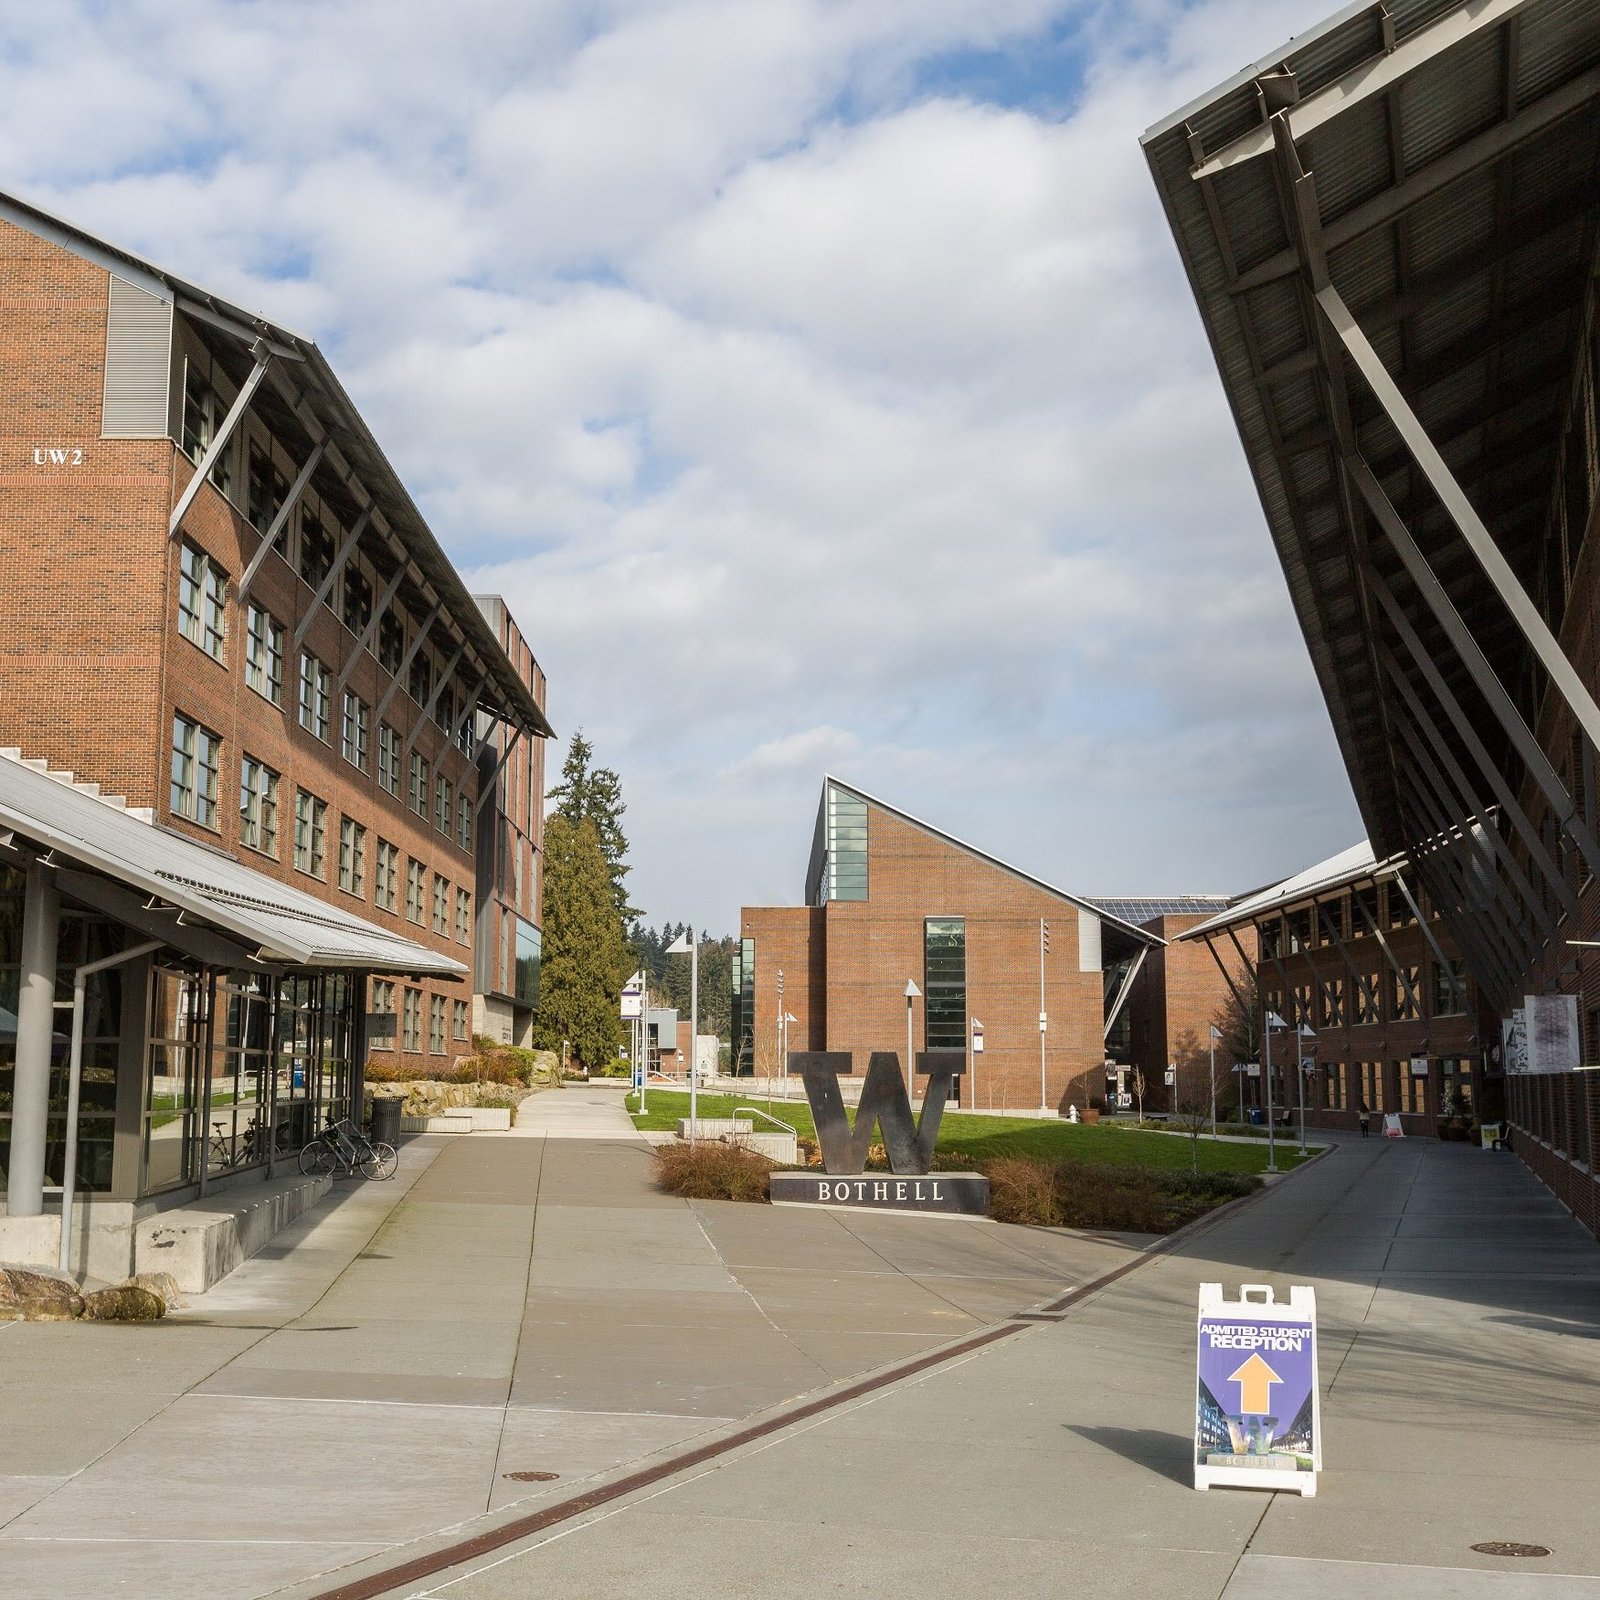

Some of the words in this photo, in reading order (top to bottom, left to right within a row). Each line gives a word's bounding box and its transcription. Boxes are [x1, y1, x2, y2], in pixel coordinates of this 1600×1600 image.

[788, 1051, 966, 1175] W
[818, 1182, 944, 1201] BOTHELL
[1200, 1324, 1258, 1336] ADMITTED
[1259, 1327, 1312, 1338] STUDENT
[1210, 1335, 1302, 1352] RECEPTION
